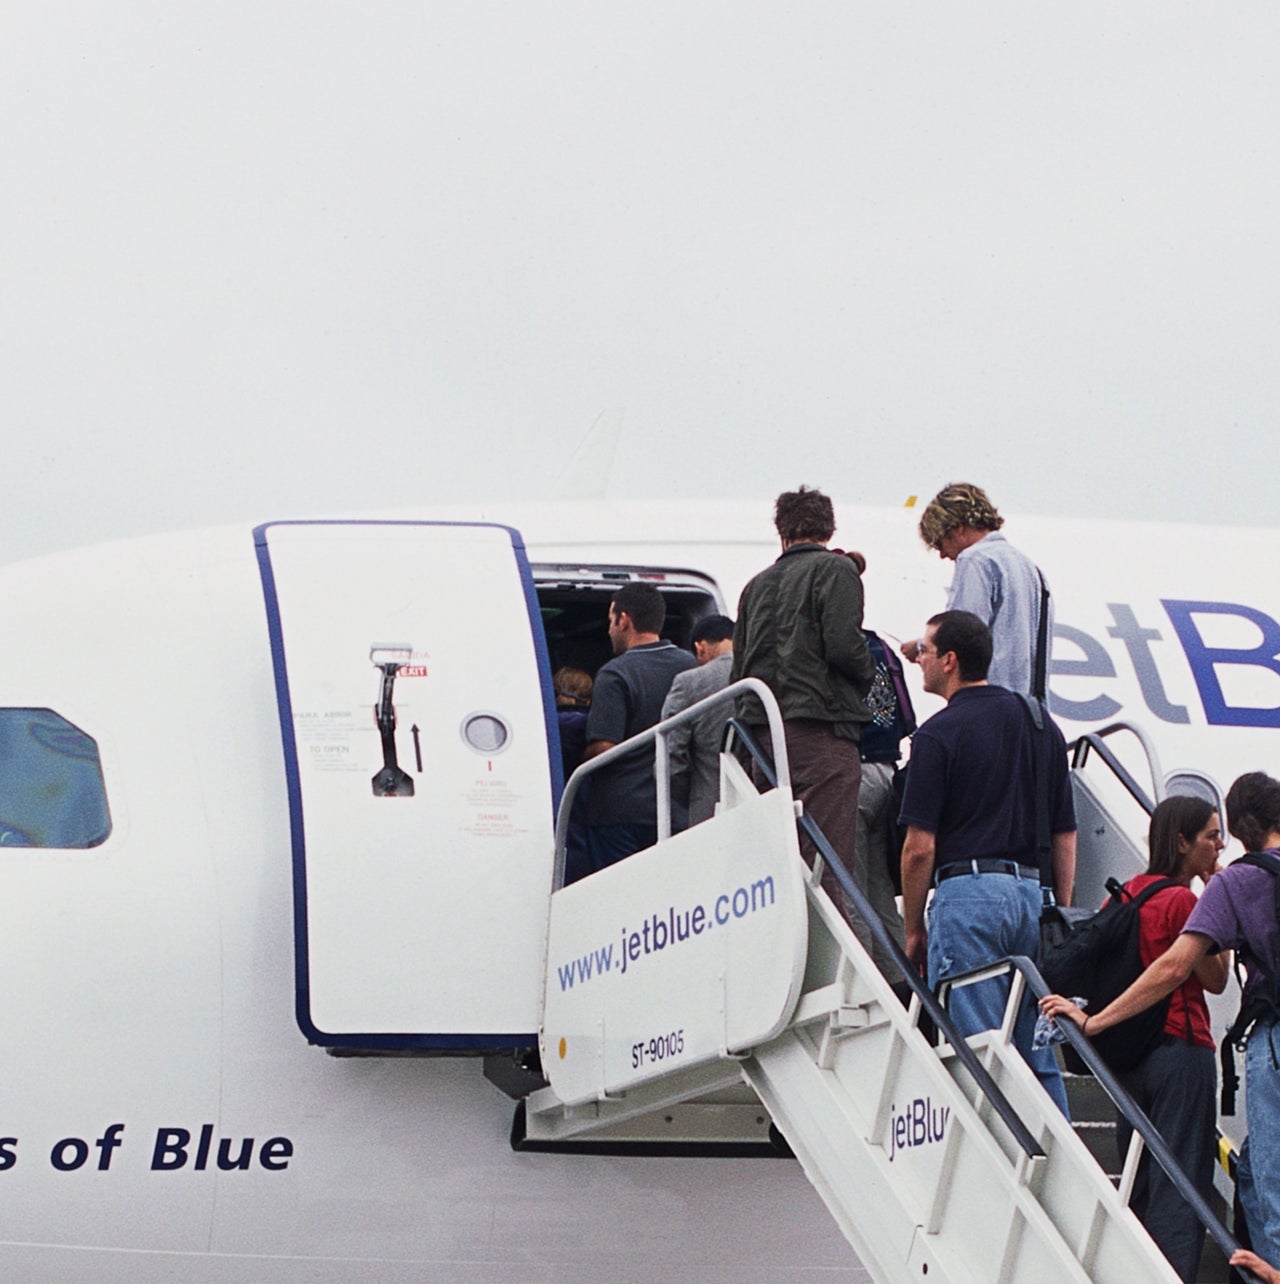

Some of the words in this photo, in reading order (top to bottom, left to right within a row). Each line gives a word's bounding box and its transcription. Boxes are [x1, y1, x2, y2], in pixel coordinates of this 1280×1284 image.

[401, 666, 426, 677] EXIT
[323, 745, 350, 753] OPEN
[558, 875, 776, 993] www.jetblue.com
[631, 1029, 685, 1069] ST-90105
[50, 1124, 125, 1171] of
[150, 1125, 295, 1171] Blue
